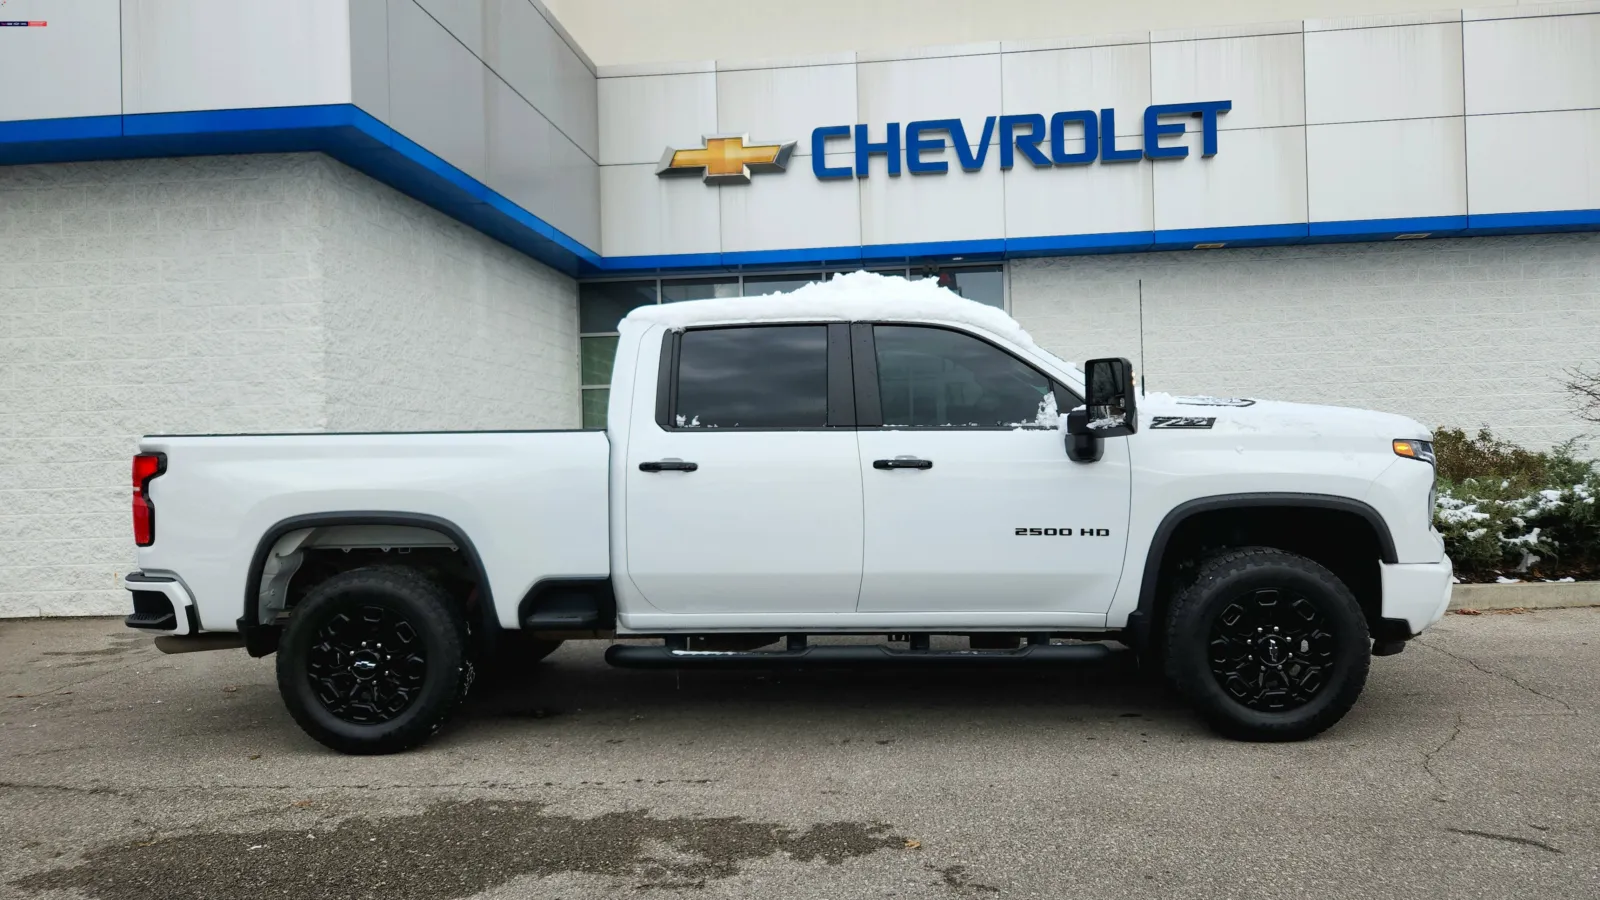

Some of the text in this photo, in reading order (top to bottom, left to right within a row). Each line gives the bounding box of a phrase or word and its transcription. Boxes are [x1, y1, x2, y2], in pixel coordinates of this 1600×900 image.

[812, 100, 1232, 181] CHEVROLET
[1015, 527, 1110, 537] 2500 HD
